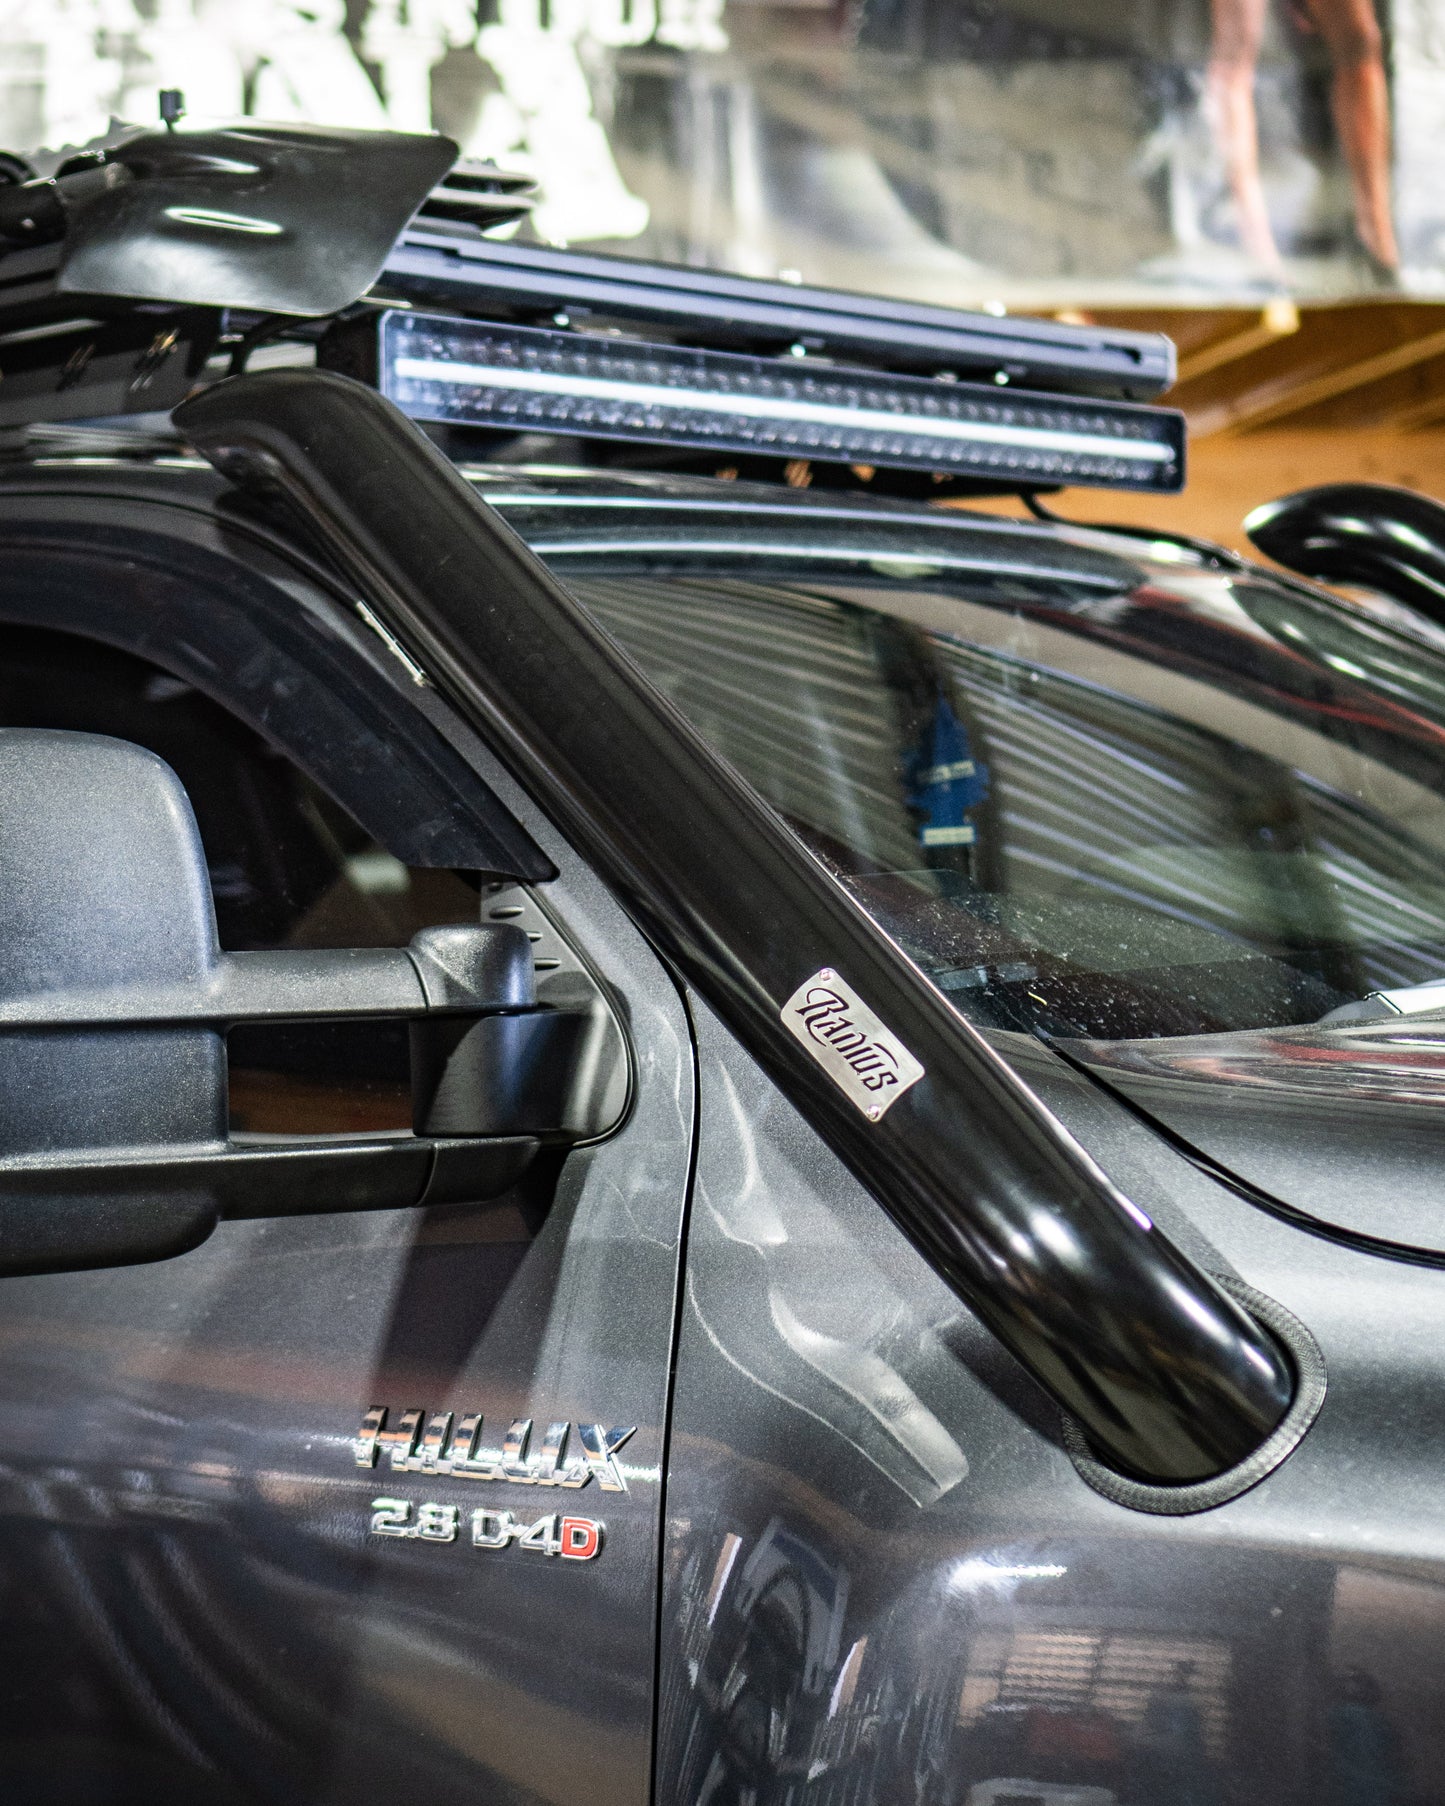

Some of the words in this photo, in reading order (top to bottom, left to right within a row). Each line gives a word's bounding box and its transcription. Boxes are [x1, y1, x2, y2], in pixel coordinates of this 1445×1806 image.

[355, 1404, 637, 1492] HILUX
[371, 1497, 458, 1542] 2.8
[472, 1508, 605, 1560] D-4D
